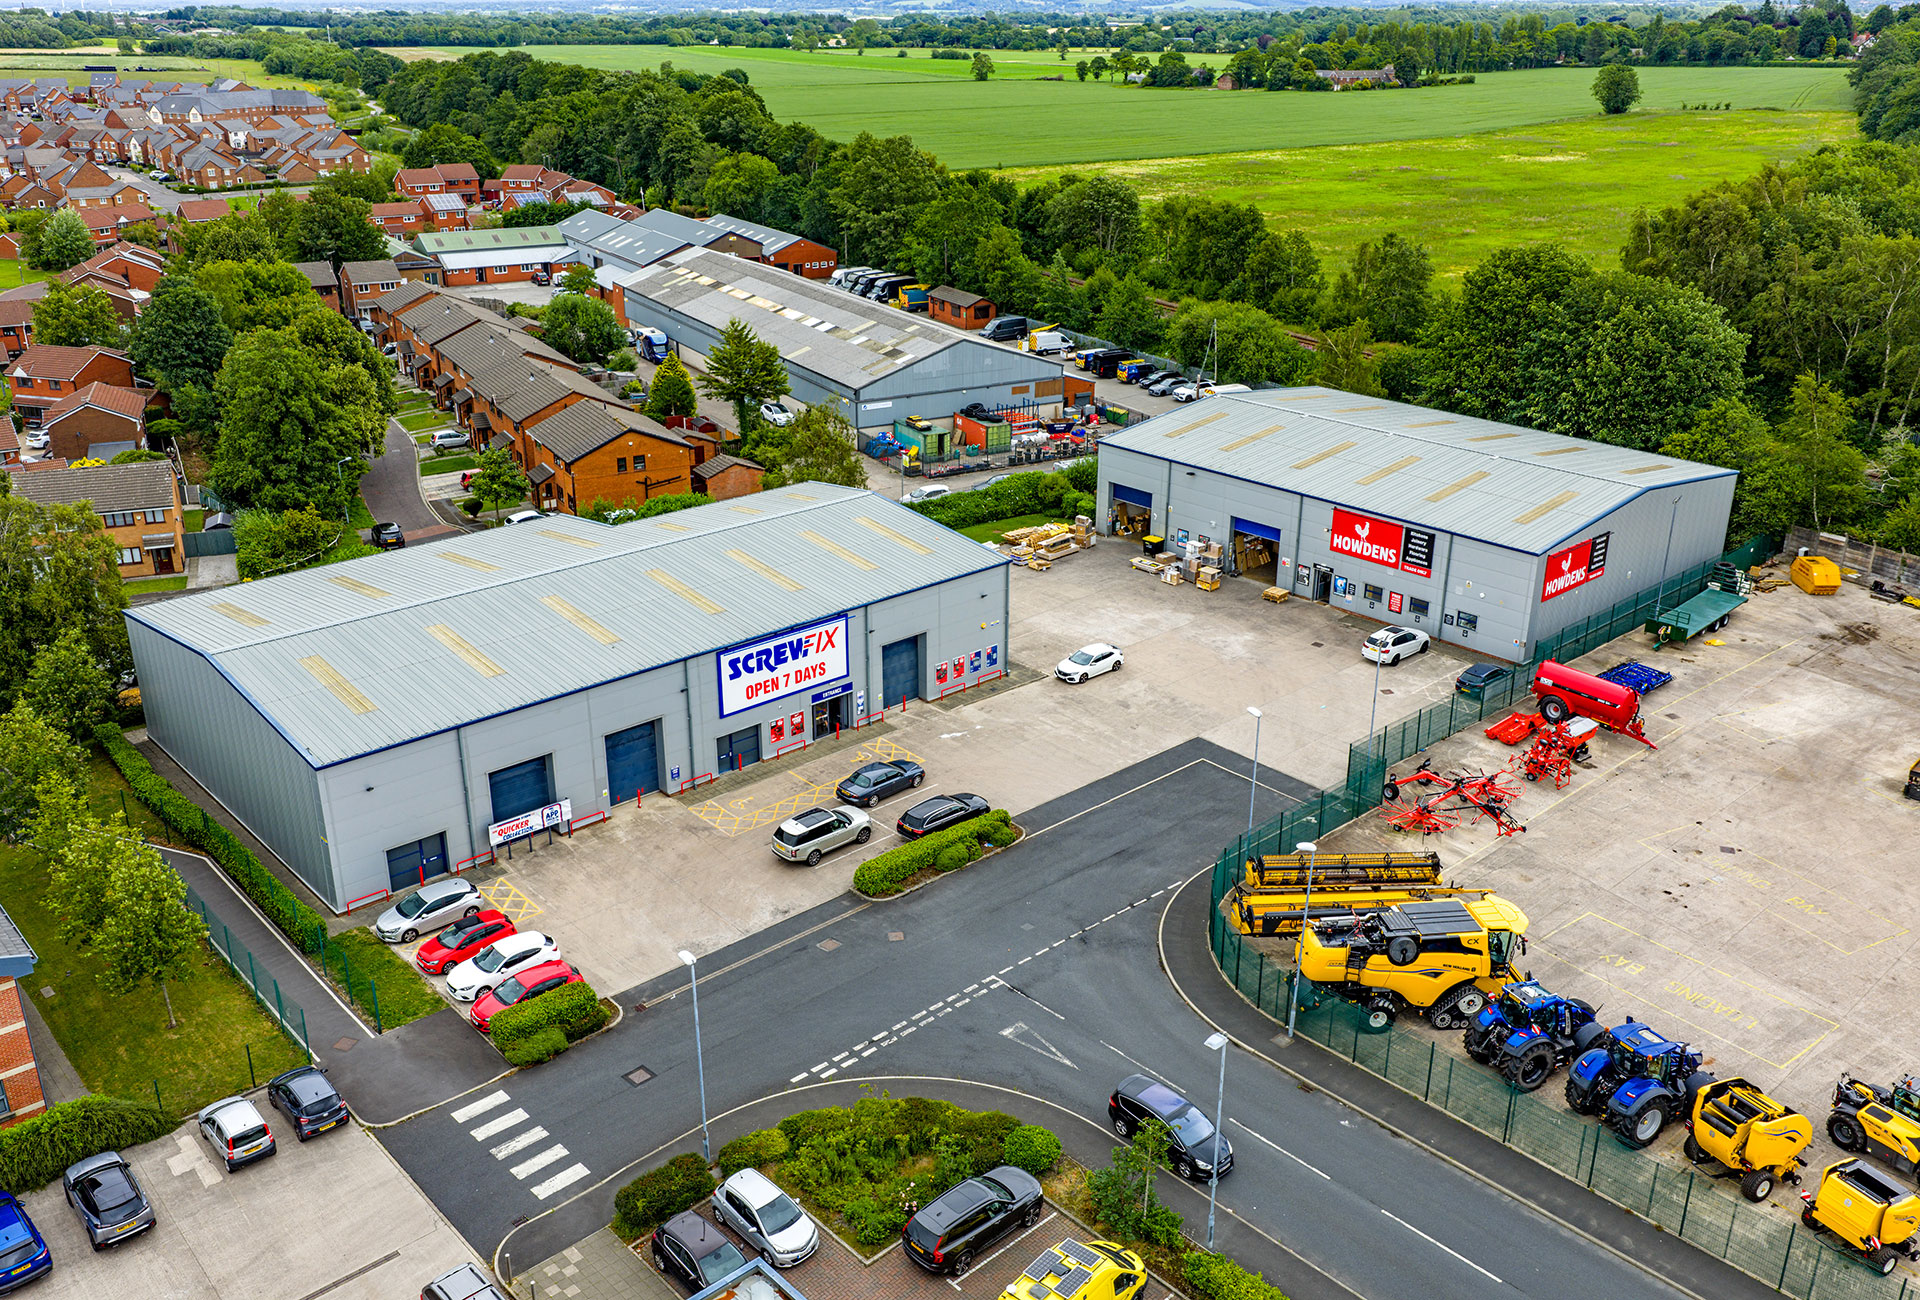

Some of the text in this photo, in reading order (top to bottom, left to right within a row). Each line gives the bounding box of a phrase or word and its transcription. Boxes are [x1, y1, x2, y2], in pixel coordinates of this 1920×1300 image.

[1333, 533, 1397, 563] HOWDENS
[1545, 566, 1587, 597] HOWDENS
[728, 626, 839, 681] SCREWFIX
[745, 661, 826, 700] OPEN 7 DAYS
[822, 687, 842, 698] ENTRANCE
[498, 819, 530, 837] QUICKER
[546, 810, 559, 820] APP
[503, 825, 534, 841] COLLECTION
[1600, 954, 1759, 1030] LOADING BAY
